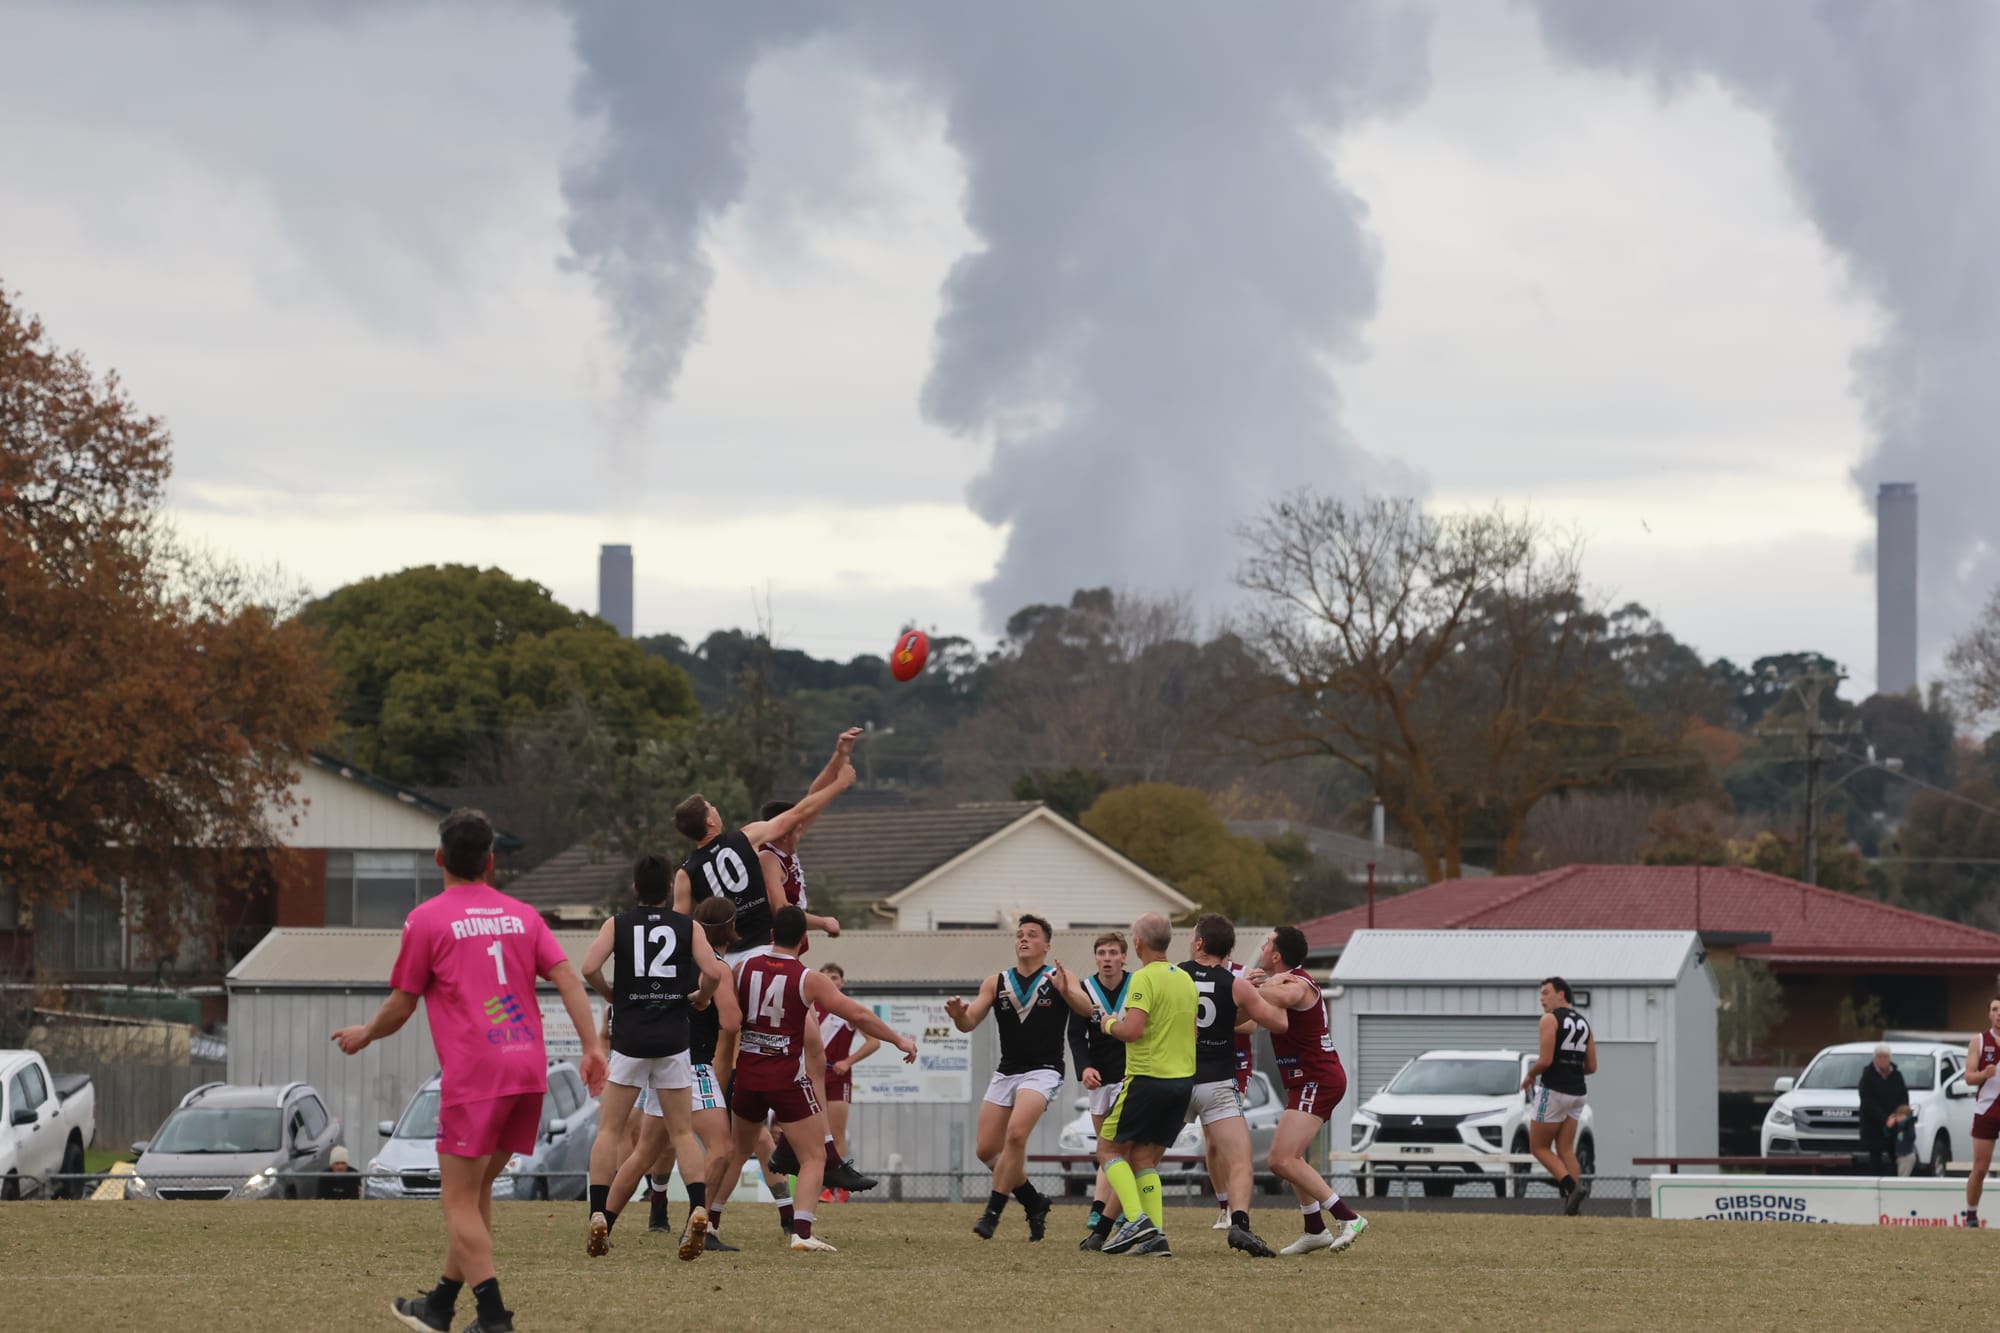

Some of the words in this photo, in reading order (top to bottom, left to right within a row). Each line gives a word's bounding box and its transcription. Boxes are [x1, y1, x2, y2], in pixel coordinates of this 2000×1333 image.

[702, 848, 749, 897] 10
[451, 916, 525, 940] RUNNER
[487, 941, 507, 985] 1
[633, 925, 677, 978] 12
[747, 970, 788, 1028] 14
[1196, 981, 1217, 1028] 5
[924, 1027, 950, 1038] AKZ
[1560, 1016, 1590, 1053] 22
[1821, 1110, 1853, 1118] ISUZU
[1715, 1194, 1806, 1212] GIBSONS
[1880, 1210, 1948, 1227] Darriman
[1953, 1211, 1988, 1227] Lie
